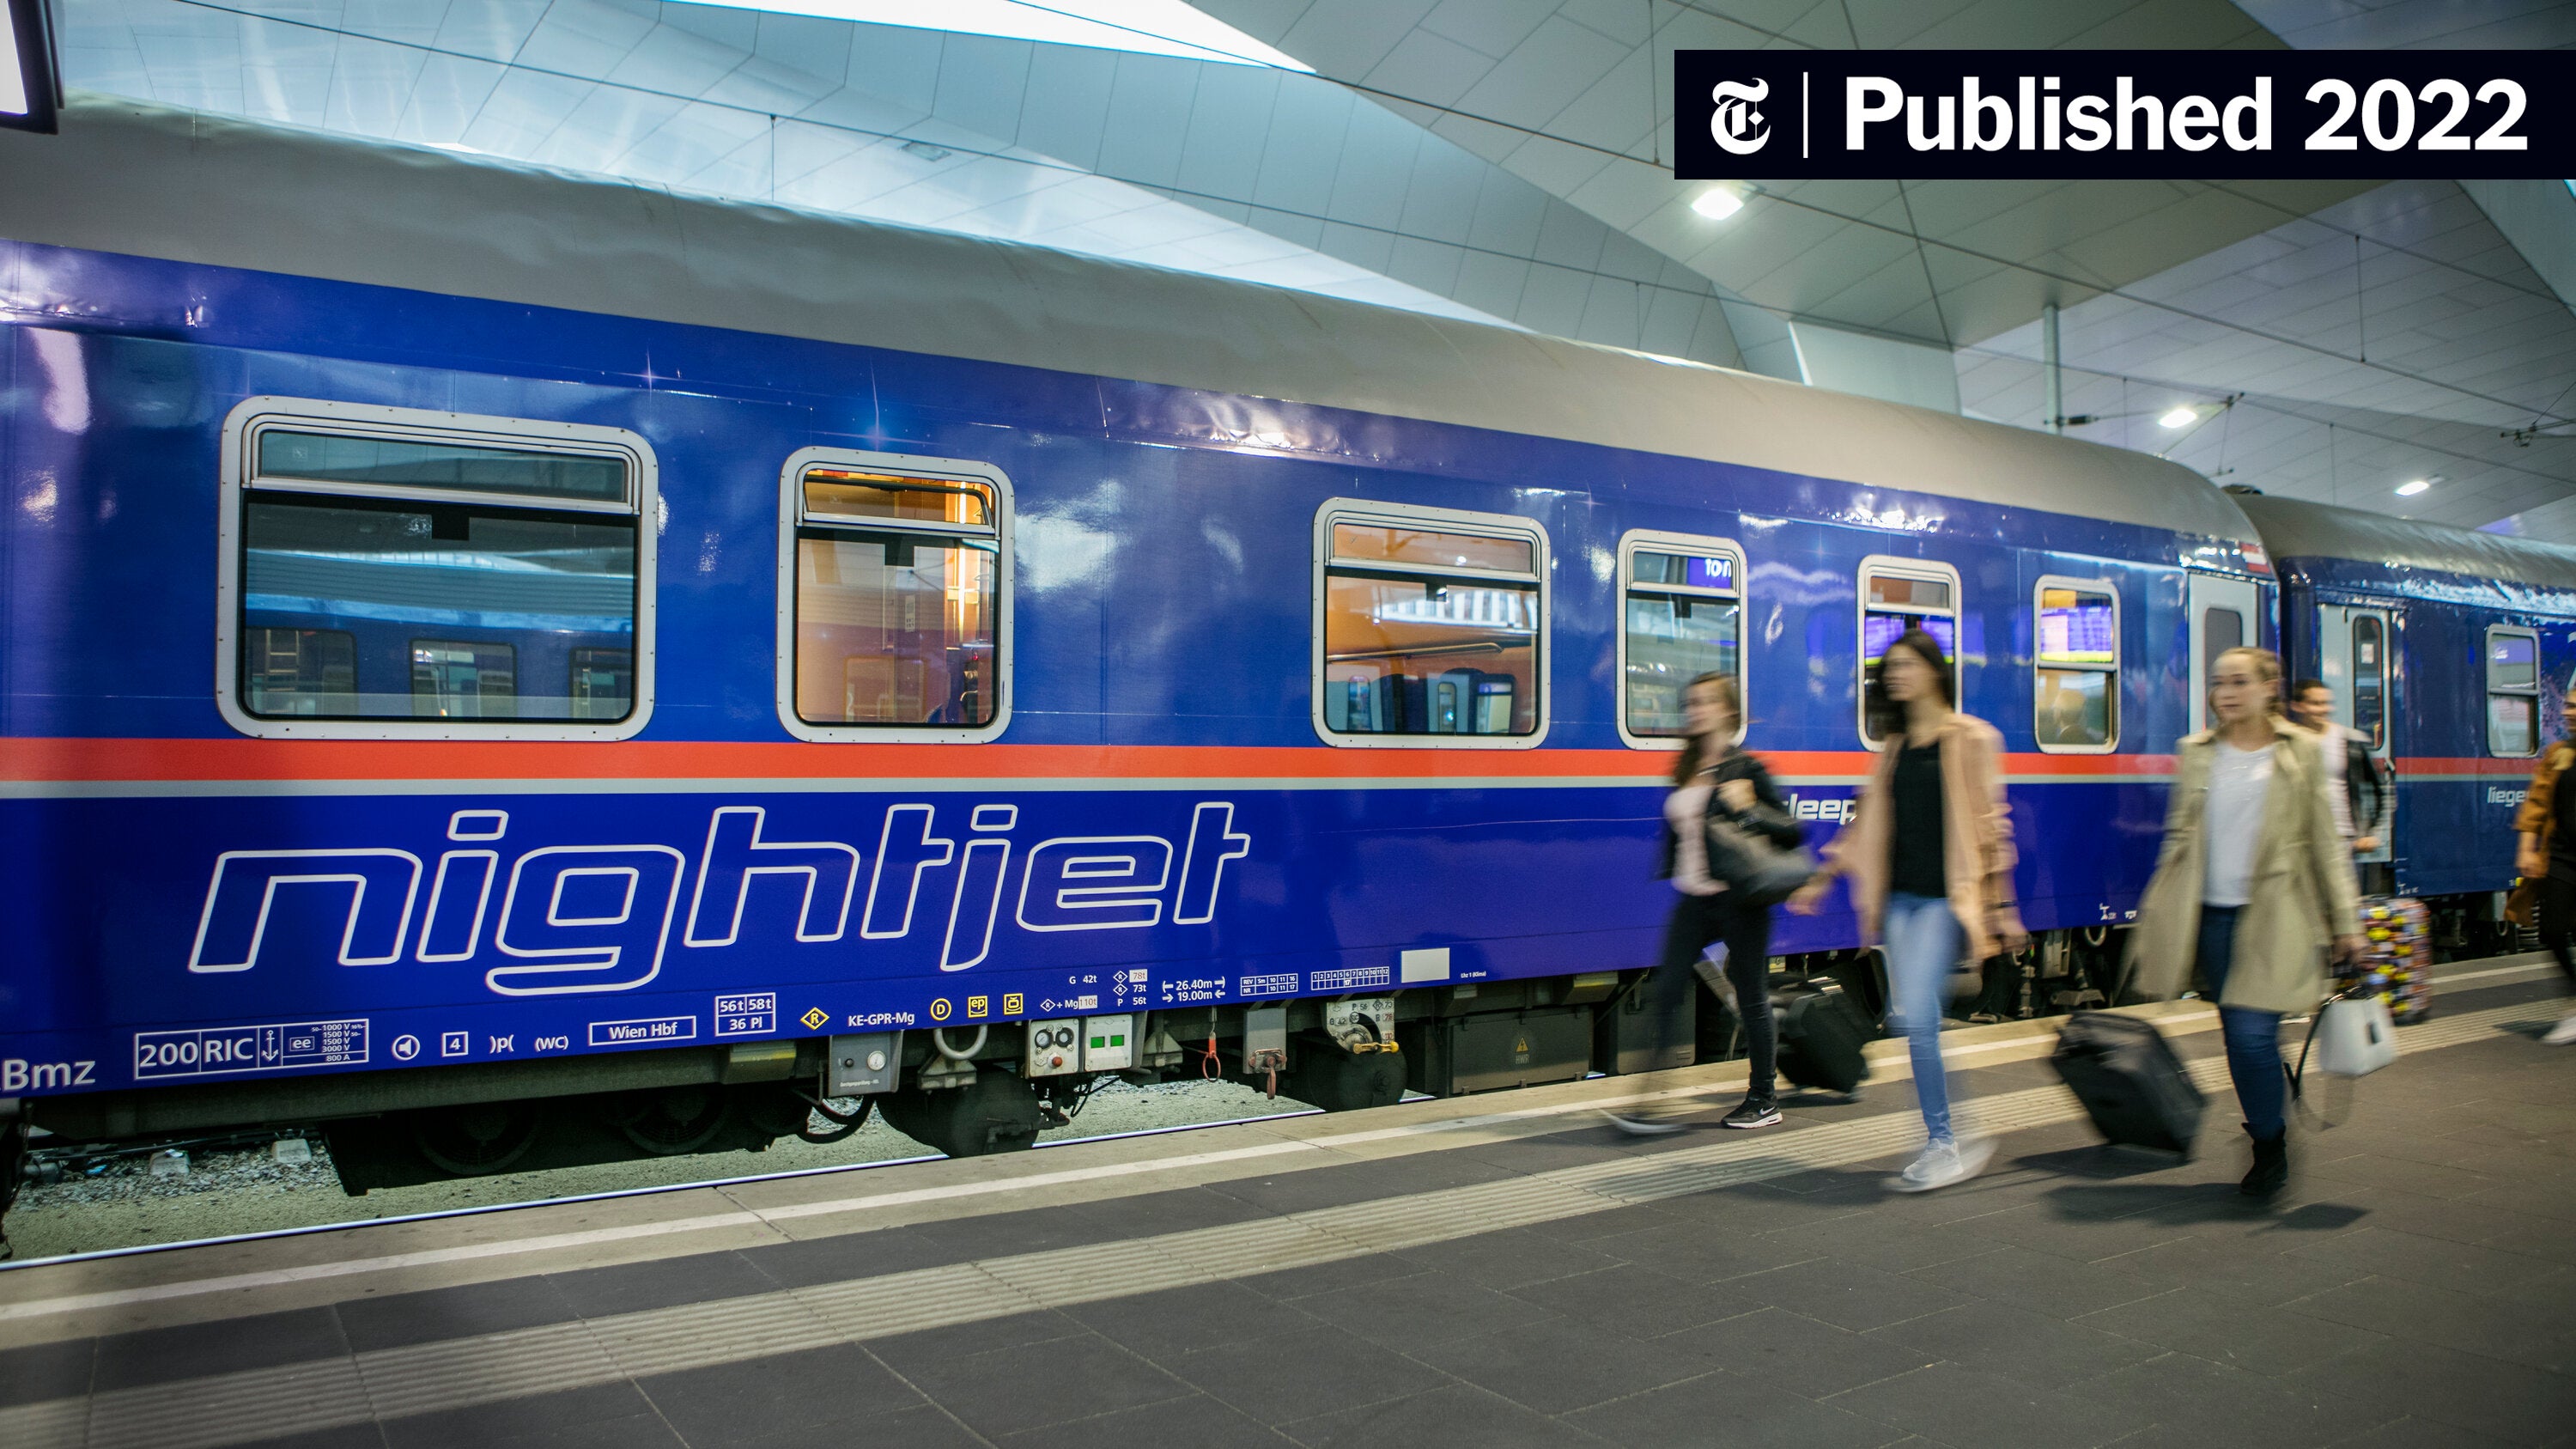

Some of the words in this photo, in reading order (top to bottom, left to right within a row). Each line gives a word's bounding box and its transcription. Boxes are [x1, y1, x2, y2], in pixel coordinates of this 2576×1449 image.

[2487, 786, 2529, 807] liege
[1780, 793, 1857, 825] leep
[188, 801, 1250, 994] nightjet
[1069, 976, 1077, 984] G
[1083, 975, 1097, 983] 42t
[1176, 980, 1212, 990] 26.40m
[1133, 984, 1146, 993] 73t
[1117, 998, 1123, 1007] P
[1177, 991, 1212, 1002] 19.00m
[1065, 999, 1078, 1010] Mg
[848, 1013, 914, 1026] KE-GPR-Mg
[937, 1004, 945, 1015] D
[729, 1018, 746, 1031] 36
[450, 1038, 460, 1050] 4
[535, 1035, 568, 1052] (WC)
[609, 1025, 647, 1040] Wien
[651, 1022, 677, 1037] Hbf
[293, 1038, 311, 1049] ee
[322, 1044, 342, 1053] 3000
[139, 1041, 198, 1067] 200
[205, 1038, 253, 1063] RIC
[0, 1059, 96, 1092] Bmz
